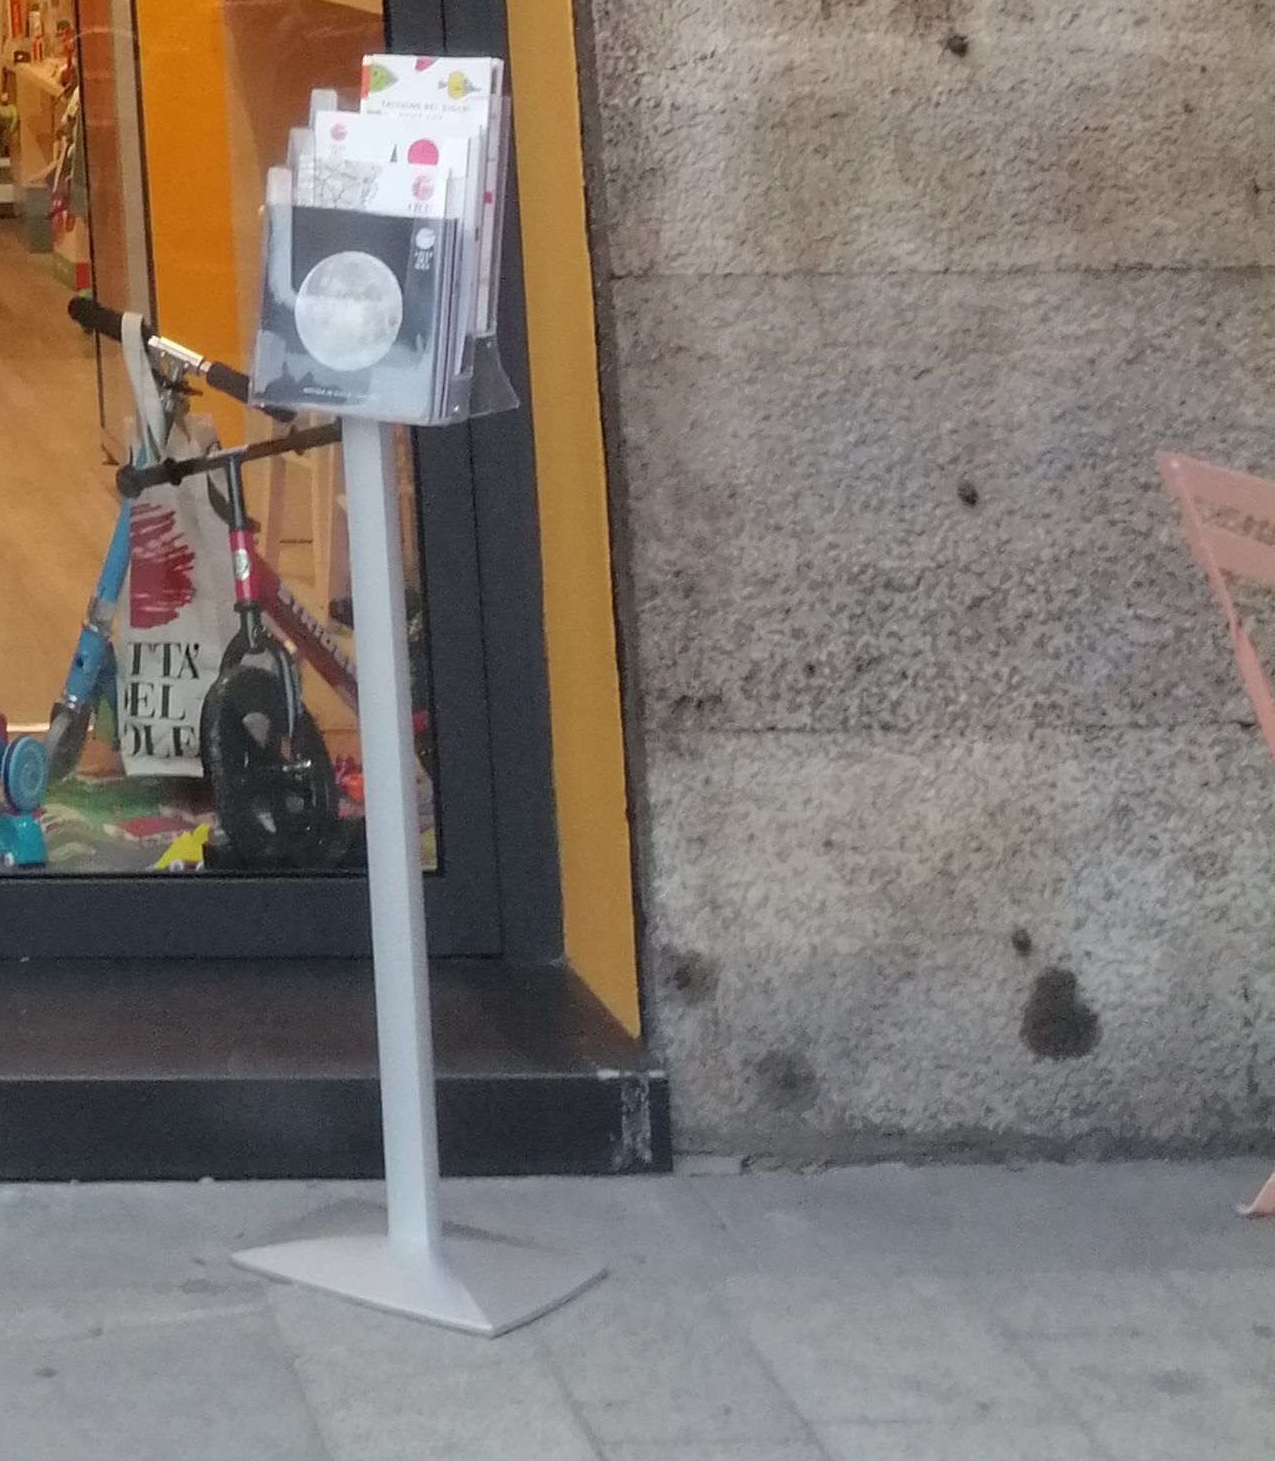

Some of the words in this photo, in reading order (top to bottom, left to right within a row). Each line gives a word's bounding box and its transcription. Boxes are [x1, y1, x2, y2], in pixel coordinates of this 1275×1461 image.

[127, 641, 200, 679] TTA'
[124, 681, 186, 721] EL
[124, 724, 201, 759] OLE
